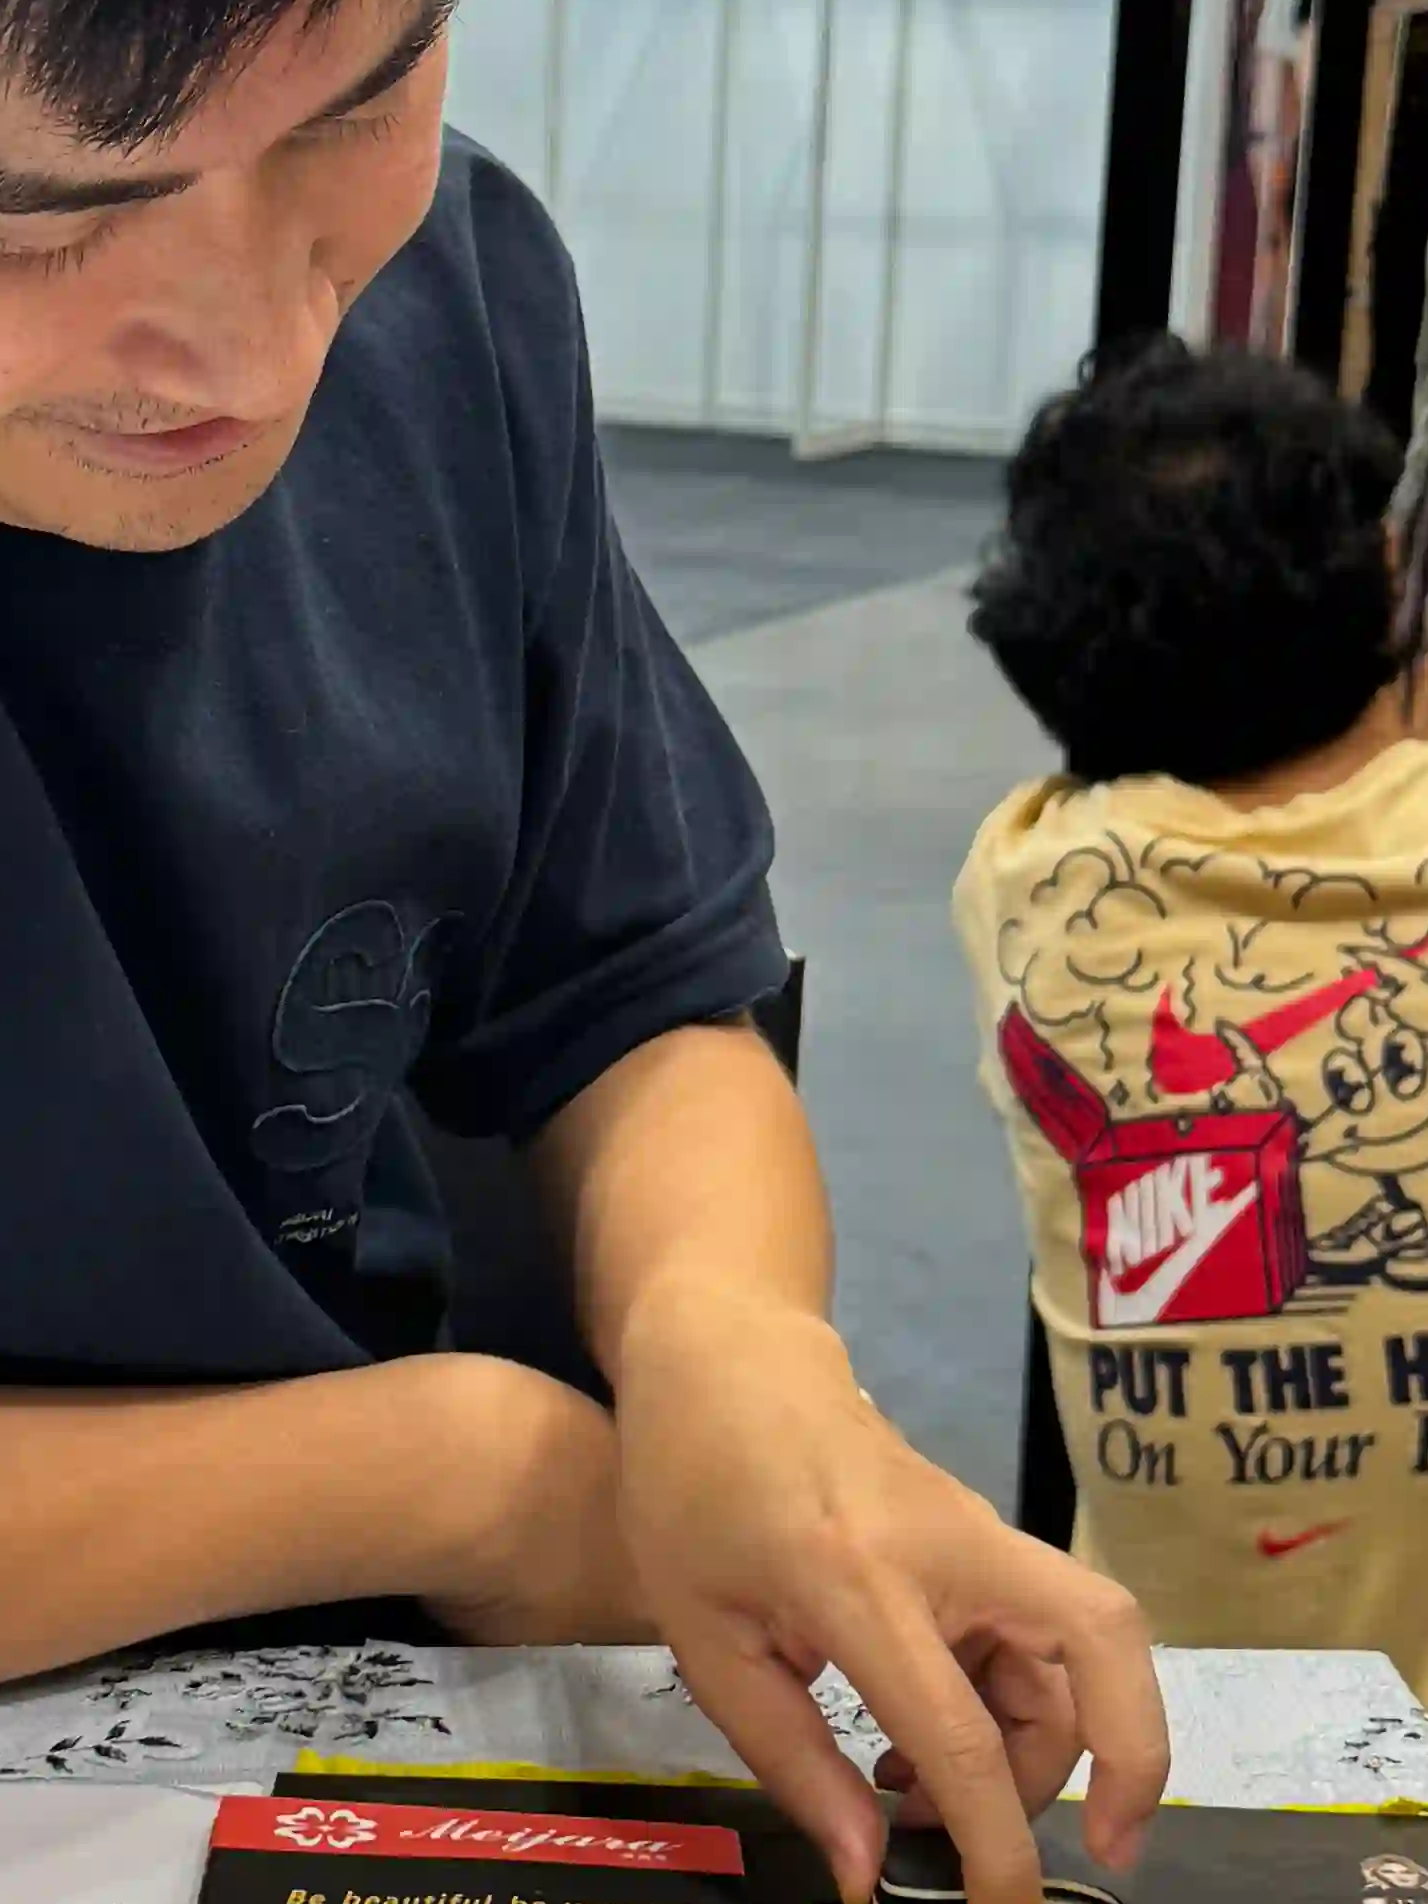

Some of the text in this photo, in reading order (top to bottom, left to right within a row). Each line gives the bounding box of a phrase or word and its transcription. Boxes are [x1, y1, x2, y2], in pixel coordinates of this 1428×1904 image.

[1105, 1152, 1227, 1275] NIKE
[1087, 1345, 1192, 1419] PUT
[1221, 1341, 1351, 1414] THE
[1095, 1420, 1179, 1488] On
[1214, 1420, 1375, 1485] Your
[398, 1816, 684, 1853] Meijara
